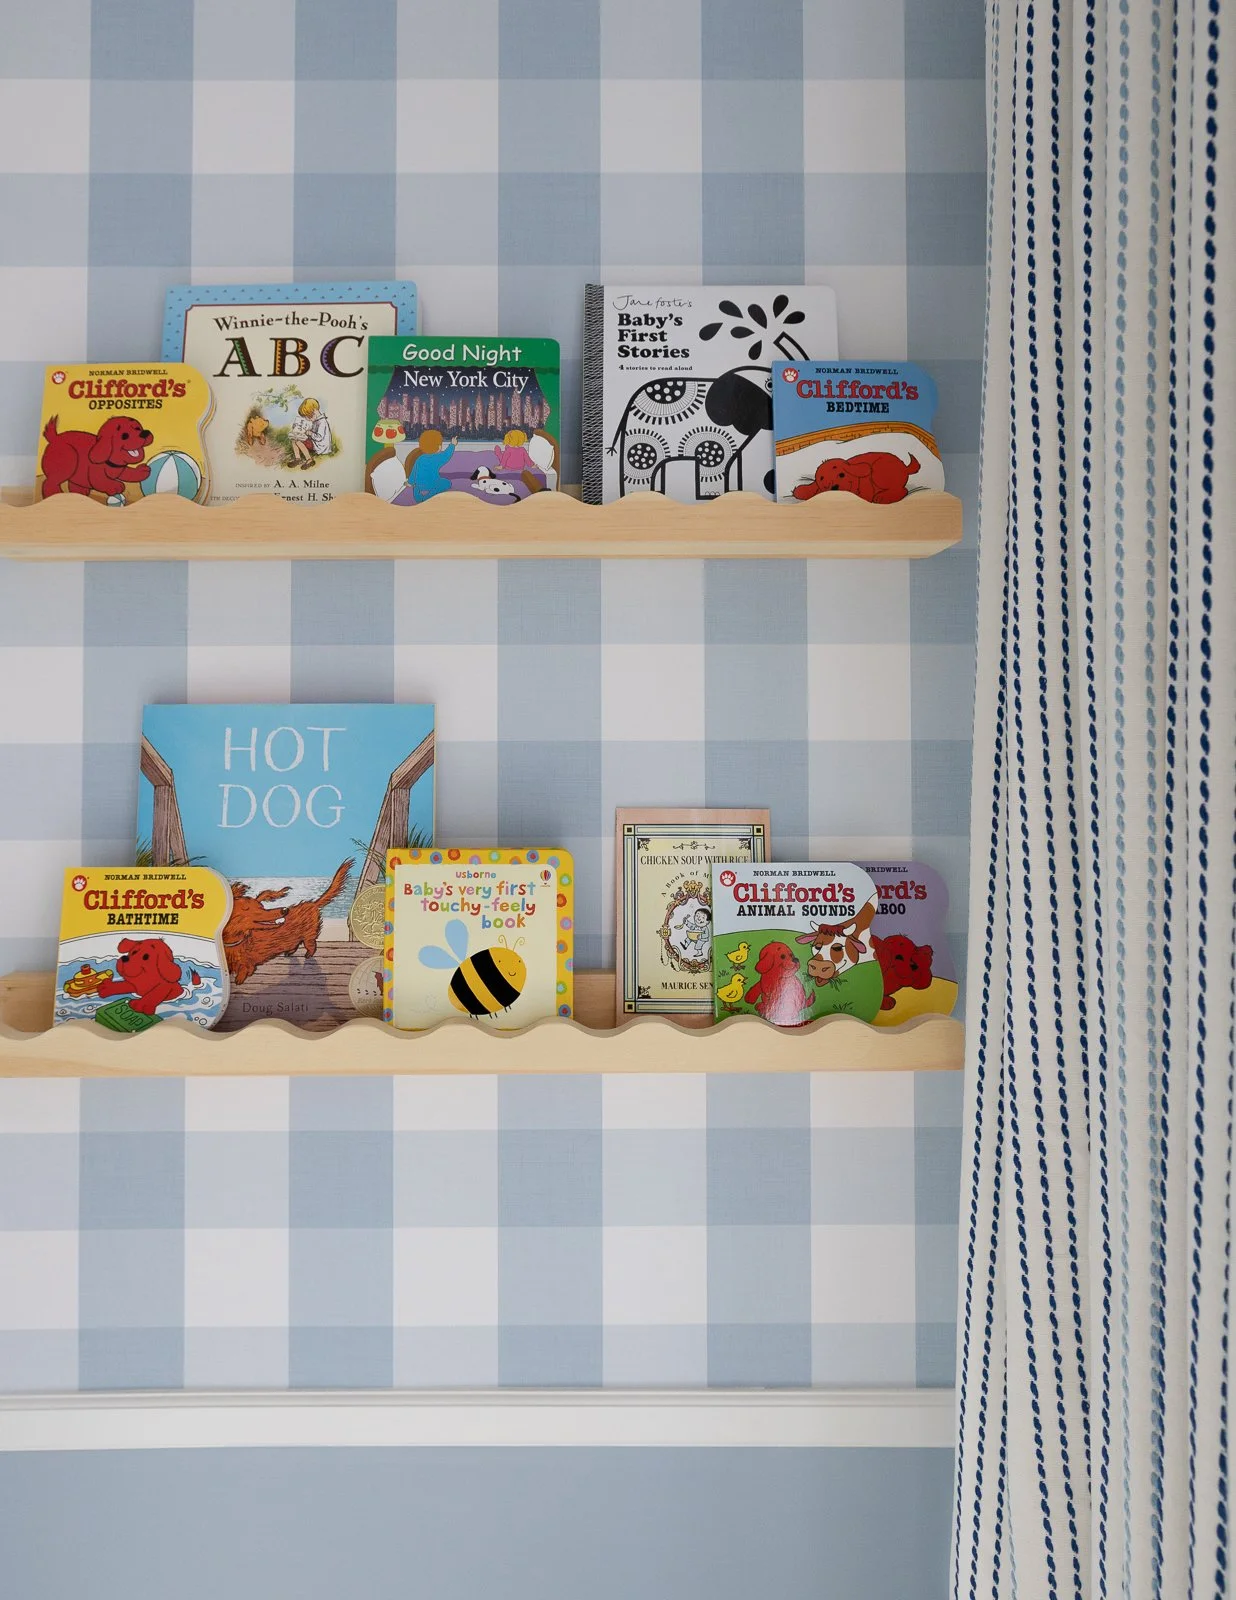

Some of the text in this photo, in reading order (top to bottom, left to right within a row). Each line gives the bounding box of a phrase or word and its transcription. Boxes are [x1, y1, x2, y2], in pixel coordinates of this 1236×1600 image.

[612, 294, 652, 310] Jane
[213, 311, 368, 331] Winnie-the-Pooh's
[617, 313, 683, 329] Baby's
[617, 329, 668, 342] First
[213, 335, 364, 378] ABC
[402, 343, 522, 366] Good Night
[617, 345, 690, 358] Stories
[68, 379, 186, 399] Clifford's
[403, 370, 529, 394] New York City
[796, 379, 919, 400] Clifford's
[88, 399, 162, 410] OPPOSITES
[826, 401, 890, 413] BEDTIME
[273, 480, 284, 488] A.
[288, 480, 300, 488] A.
[303, 480, 330, 488] Milne
[307, 493, 318, 502] H.
[224, 726, 346, 772] HOT
[217, 783, 346, 828] DOG
[640, 855, 748, 865] CHICKEN SOUP WITH RICE
[455, 870, 496, 878] usborne
[666, 872, 685, 888] Book
[403, 881, 454, 899] Baby's
[458, 885, 492, 899] very
[496, 880, 536, 896] first
[733, 883, 856, 903] Clifford's
[83, 888, 204, 910] Clifford's
[420, 897, 536, 916] touchy-feely
[736, 904, 856, 916] ANIMAL SOUNDS
[107, 913, 178, 926] BATHTIME
[481, 913, 526, 929] book
[661, 982, 714, 990] MAURICE SEN
[115, 1004, 144, 1026] SOAP
[242, 1001, 308, 1016] Doug Salati
